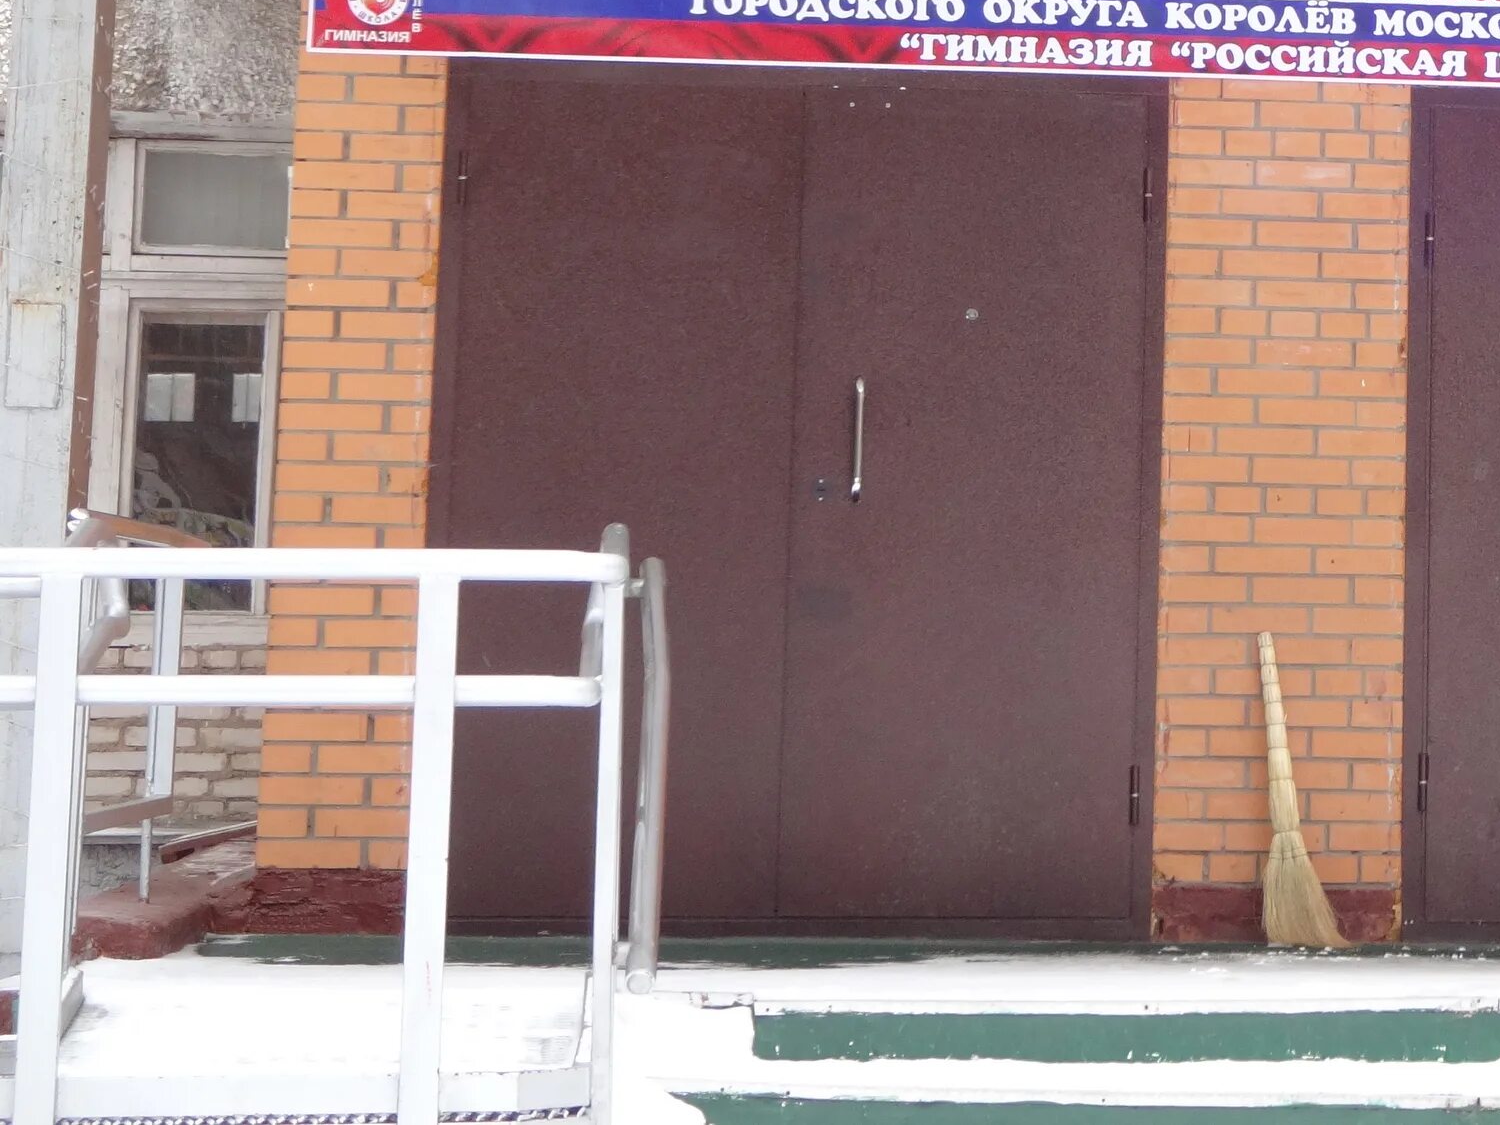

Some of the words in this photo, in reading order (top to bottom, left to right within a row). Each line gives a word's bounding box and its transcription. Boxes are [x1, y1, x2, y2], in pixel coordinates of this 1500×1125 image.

[357, 10, 398, 24] ШКОЛА
[324, 29, 410, 43] ГИМНАЗИЯ
[900, 31, 1152, 68] “ГИМНАЗИЯ
[1171, 40, 1467, 77] “РОССИЙСКАЯ
